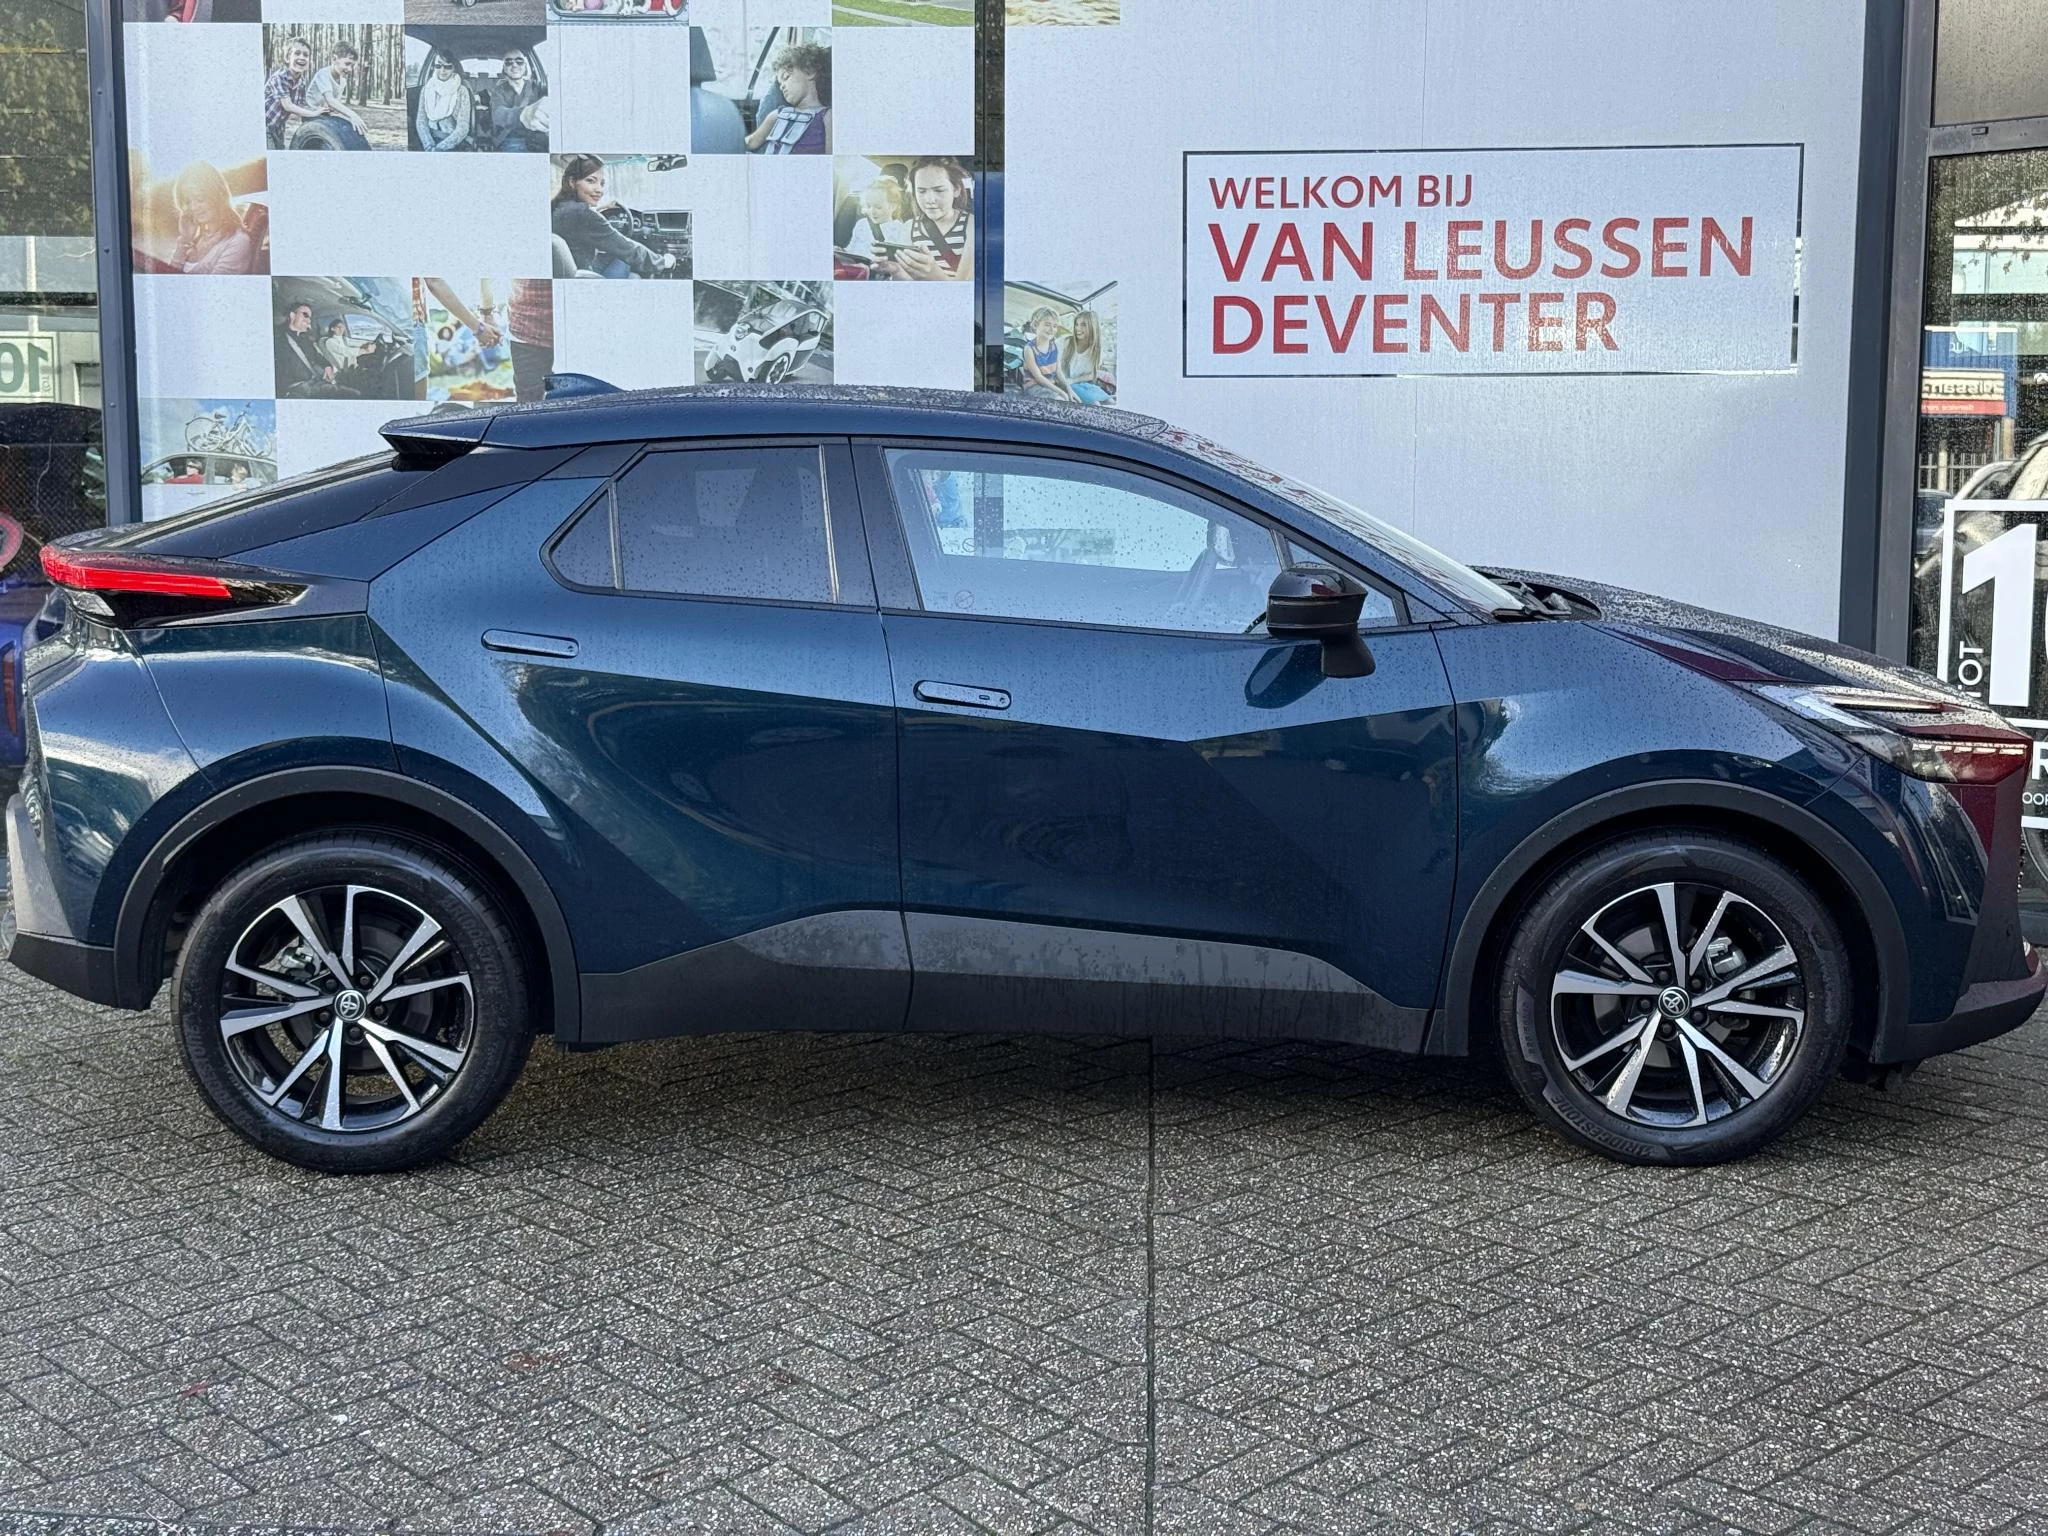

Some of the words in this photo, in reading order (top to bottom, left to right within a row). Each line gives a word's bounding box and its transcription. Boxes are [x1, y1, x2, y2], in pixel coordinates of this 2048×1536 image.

[1209, 175, 1402, 209] WELKOM
[1417, 174, 1472, 207] BIJ
[1208, 221, 1374, 282] VAN
[1404, 216, 1753, 281] LEUSSEN
[1212, 292, 1619, 354] DEVENTER
[1961, 523, 2048, 707] 1
